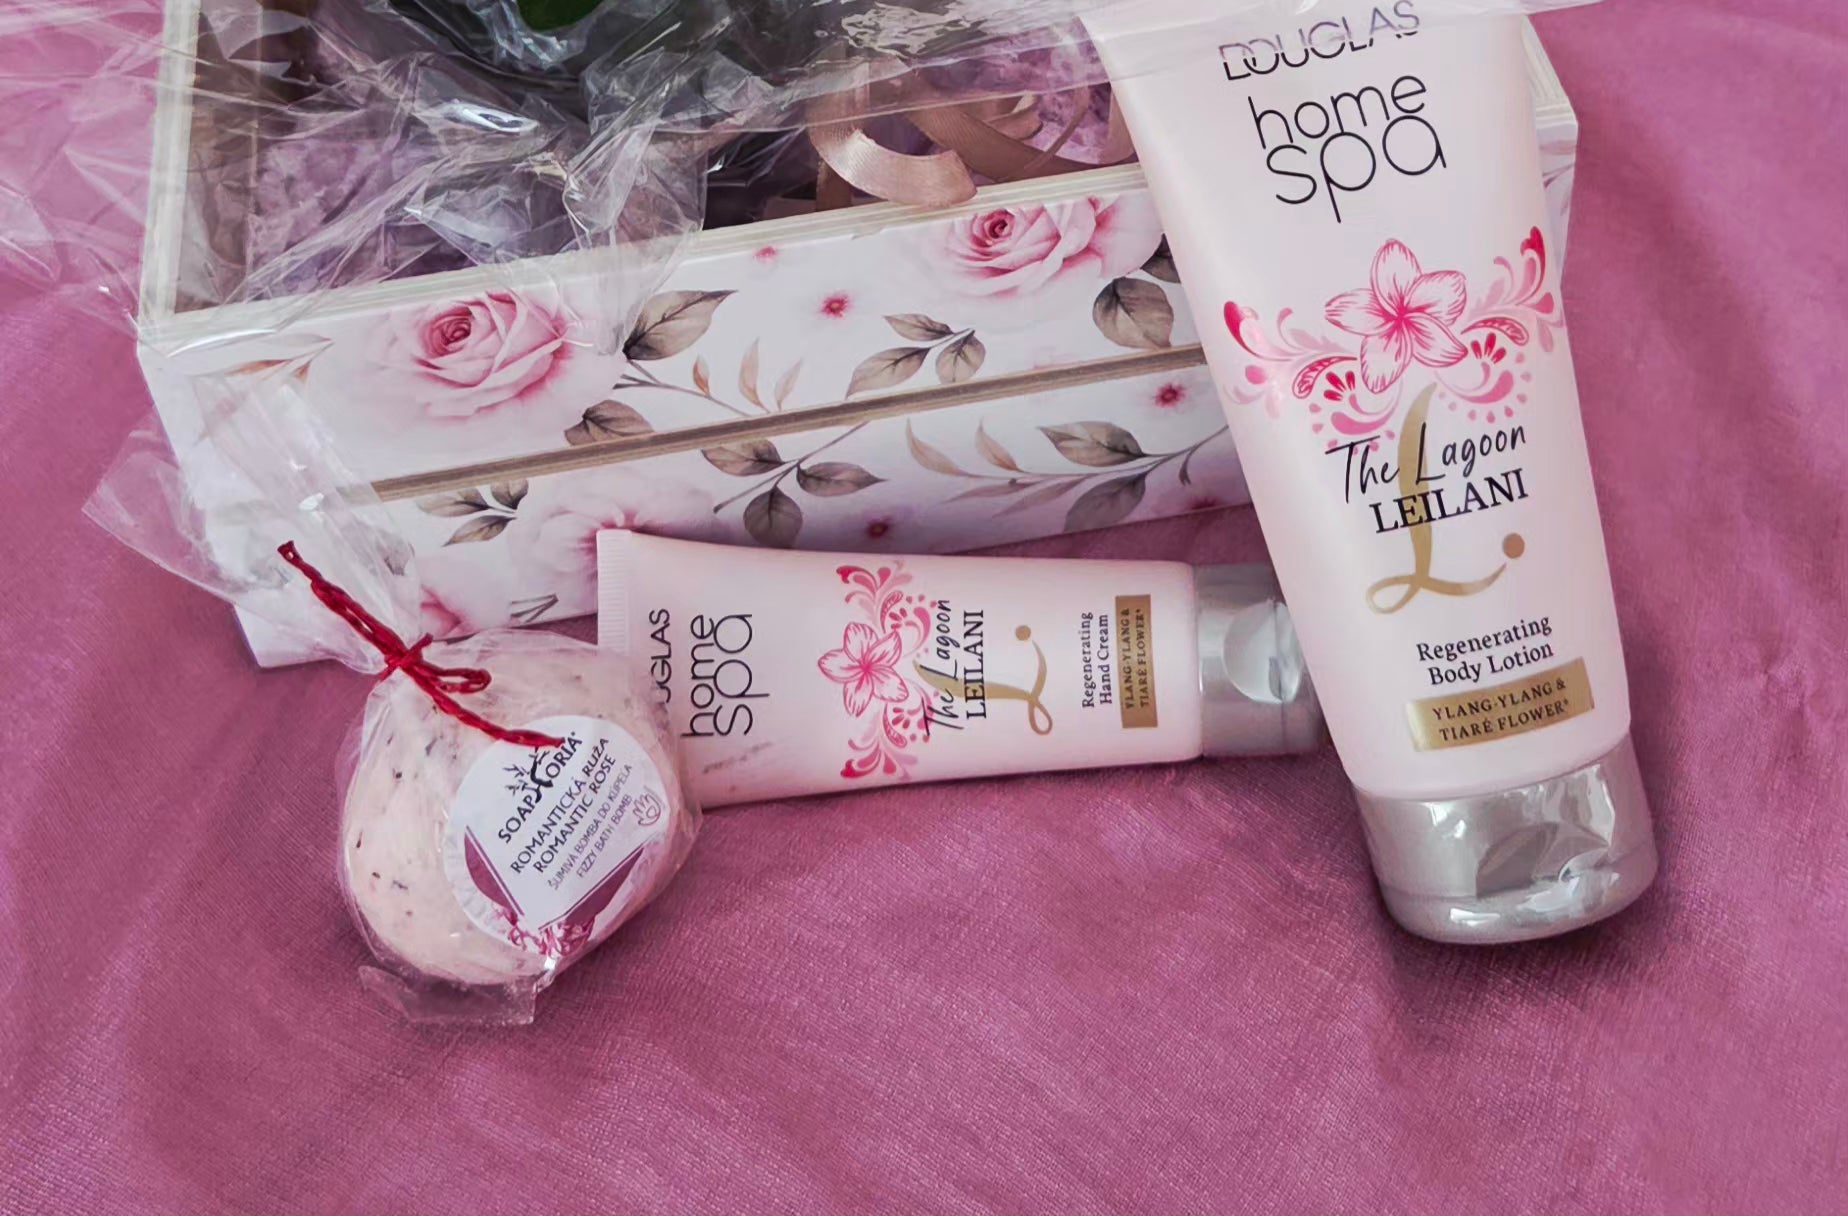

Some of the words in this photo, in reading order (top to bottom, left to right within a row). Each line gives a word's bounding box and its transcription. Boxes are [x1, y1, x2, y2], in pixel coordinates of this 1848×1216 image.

[1219, 0, 1420, 80] DOUGLAS
[1248, 76, 1426, 149] home
[1267, 115, 1447, 223] spa
[1325, 435, 1400, 504] The
[1416, 422, 1526, 485] Lagoon
[1369, 468, 1528, 533] LEILANI
[680, 614, 715, 737] home
[713, 613, 770, 736] spa
[919, 599, 960, 681] Lagoon
[963, 610, 987, 719] LEILANI
[1080, 611, 1096, 708] Regenerating
[1097, 614, 1110, 660] Cream
[1416, 616, 1552, 661] Regenerating
[1428, 661, 1481, 685] Body
[1487, 643, 1554, 674] Lotion
[921, 688, 964, 736] The
[1097, 664, 1112, 704] Hand
[1433, 684, 1553, 720] YLANG-YLANG
[1556, 678, 1566, 690] &
[1439, 719, 1494, 741] TIARÉ
[532, 793, 594, 873] ROMANTIC
[589, 754, 616, 794] ROSE
[576, 849, 598, 878] FIZZY
[594, 823, 615, 851] BATH
[611, 794, 632, 825] BOMB
